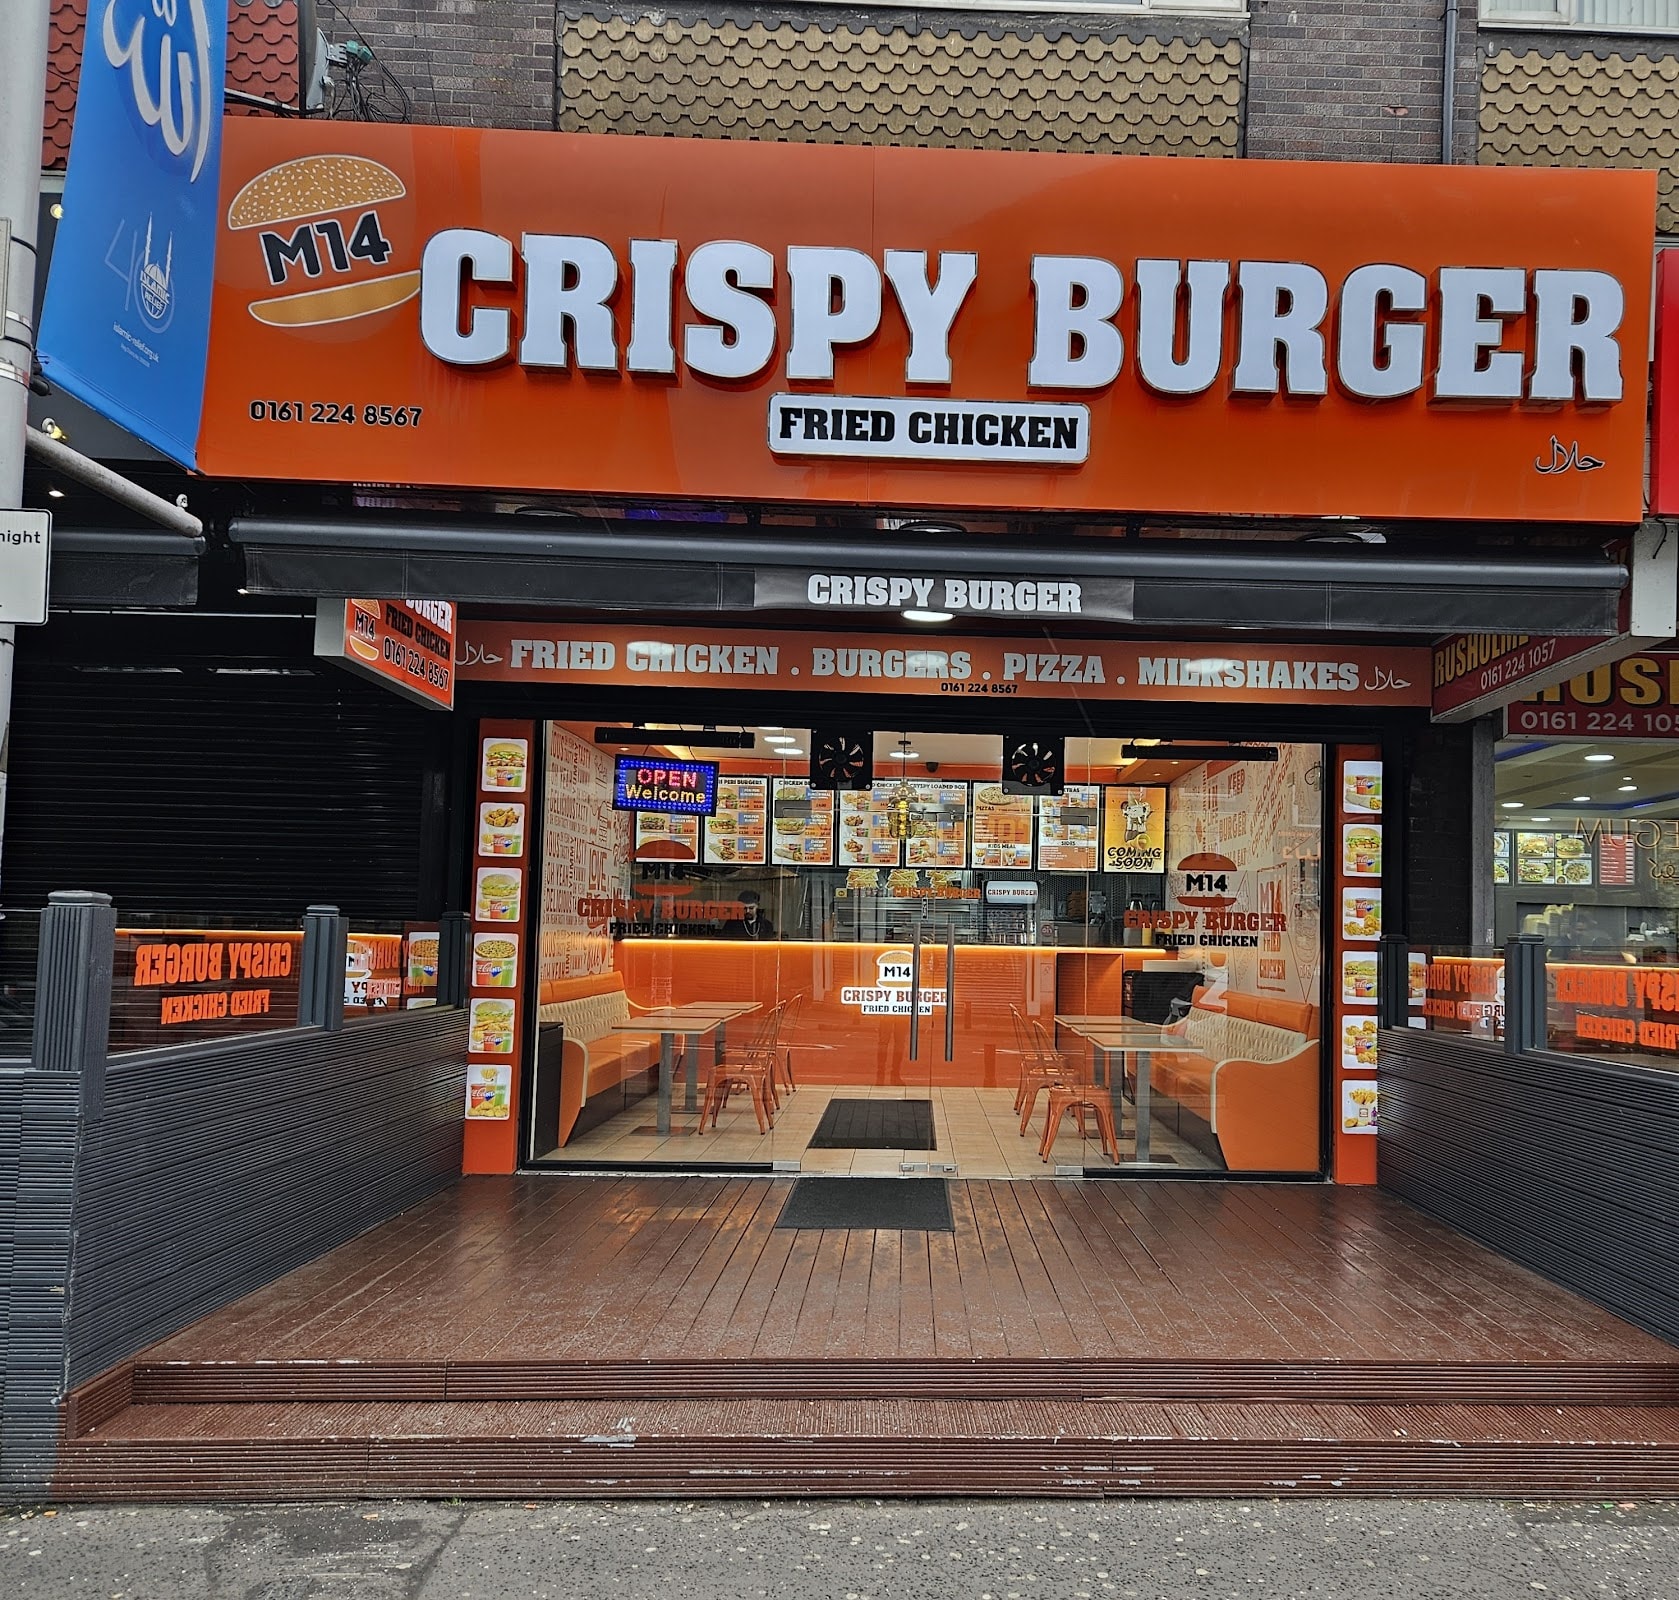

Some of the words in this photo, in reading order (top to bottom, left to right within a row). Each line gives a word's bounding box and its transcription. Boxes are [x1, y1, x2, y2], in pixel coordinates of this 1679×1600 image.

[258, 210, 392, 285] M14
[420, 227, 979, 385] CRISPY
[1028, 254, 1626, 402] BURGER
[250, 400, 302, 423] 0161
[311, 403, 355, 424] 224
[364, 405, 422, 428] 8567
[780, 407, 895, 443] FRIED
[908, 411, 1079, 449] CHICKEN
[1534, 434, 1605, 475] حلال
[808, 574, 934, 607] CRISPY
[944, 579, 1082, 612] BURGER
[355, 608, 376, 642] M14
[405, 599, 452, 634] URGER
[386, 603, 413, 638] FRIED
[415, 622, 451, 661] CHICKEN
[384, 636, 406, 670] 0161
[408, 649, 426, 680] 224
[428, 660, 450, 691] 8567
[511, 639, 615, 670] FRIED
[626, 641, 779, 675] CHICKEN
[812, 648, 971, 680] BURGERS
[1004, 652, 1106, 684] PIZZA
[1481, 664, 1502, 690] 0161
[1505, 653, 1526, 680] 224
[1528, 638, 1556, 668] 1057
[941, 682, 966, 694] 0161
[968, 682, 988, 694] 224
[991, 683, 1018, 694] 8567
[1138, 656, 1360, 692] MILKSHAKES
[1364, 666, 1412, 692] حلال
[1521, 712, 1576, 730] 0161
[1587, 712, 1634, 732] 224
[638, 768, 696, 788] OPEN
[626, 784, 706, 804] Welcome
[1107, 847, 1161, 859] COMING
[1186, 874, 1228, 892] M14
[577, 898, 654, 918] CRISPY
[661, 900, 745, 920] BURGER
[1124, 910, 1198, 930] CRISPY
[1205, 912, 1287, 932] BURGER
[610, 922, 650, 934] FRIED
[652, 923, 718, 936] CHICKEN
[1156, 934, 1195, 946] FRIED
[1200, 934, 1258, 947] CHICKEN
[884, 966, 911, 978] M14
[843, 990, 892, 1002] CRISPY
[864, 1005, 889, 1013] FRIED
[892, 1005, 931, 1013] CHICEN
